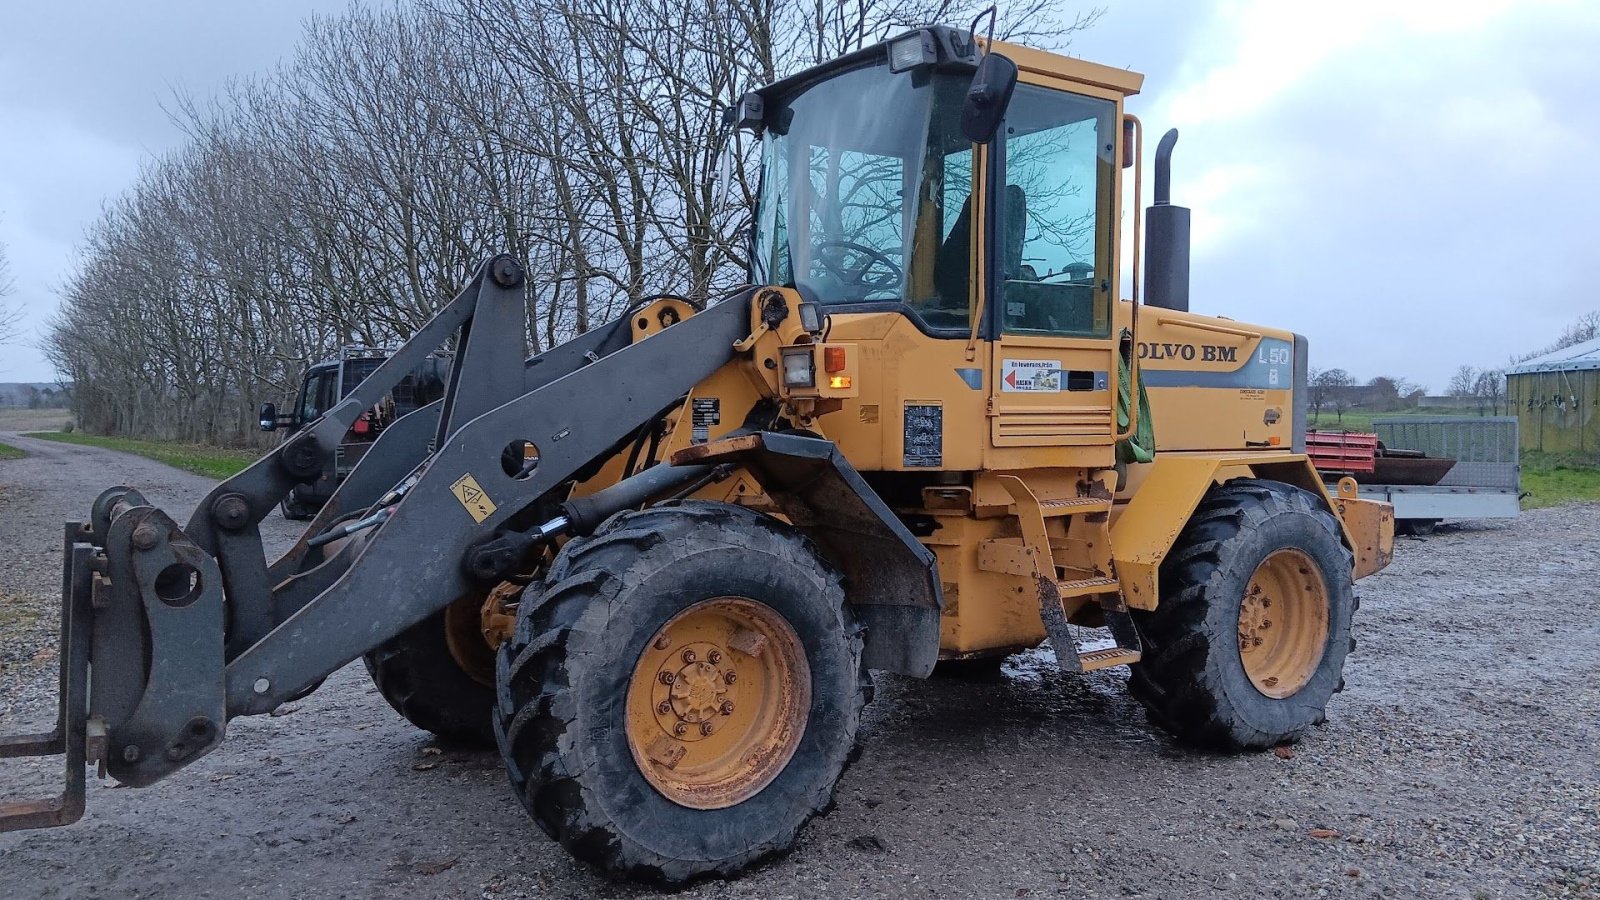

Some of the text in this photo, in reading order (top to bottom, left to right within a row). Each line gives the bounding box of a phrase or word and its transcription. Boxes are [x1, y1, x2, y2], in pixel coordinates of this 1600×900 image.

[1137, 342, 1238, 362] OLVO BM
[1269, 368, 1279, 385] B
